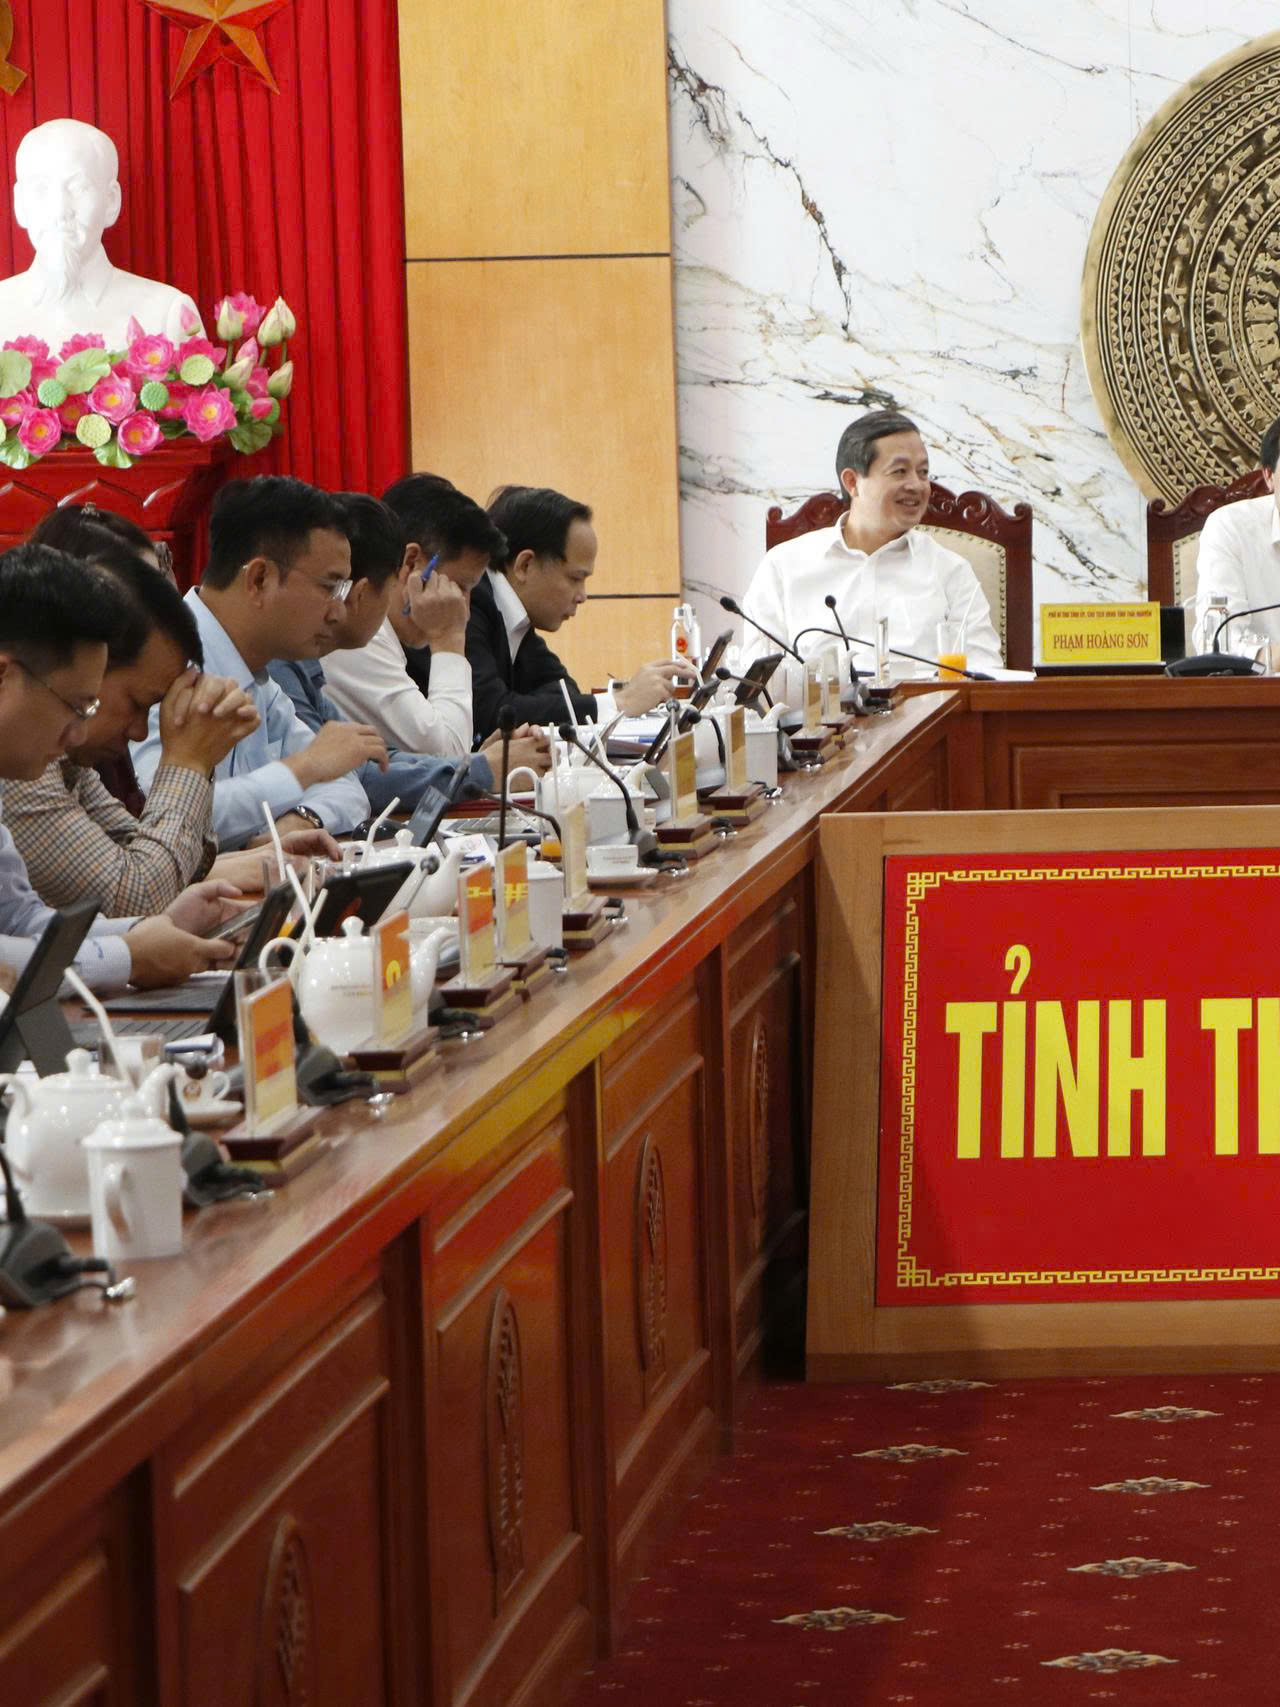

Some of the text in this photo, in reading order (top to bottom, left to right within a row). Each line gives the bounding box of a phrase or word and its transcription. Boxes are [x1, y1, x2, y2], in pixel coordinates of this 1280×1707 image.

[1053, 629, 1149, 652] PHẠM HOÀNG SƠN
[945, 944, 1166, 1158] TỈNH
